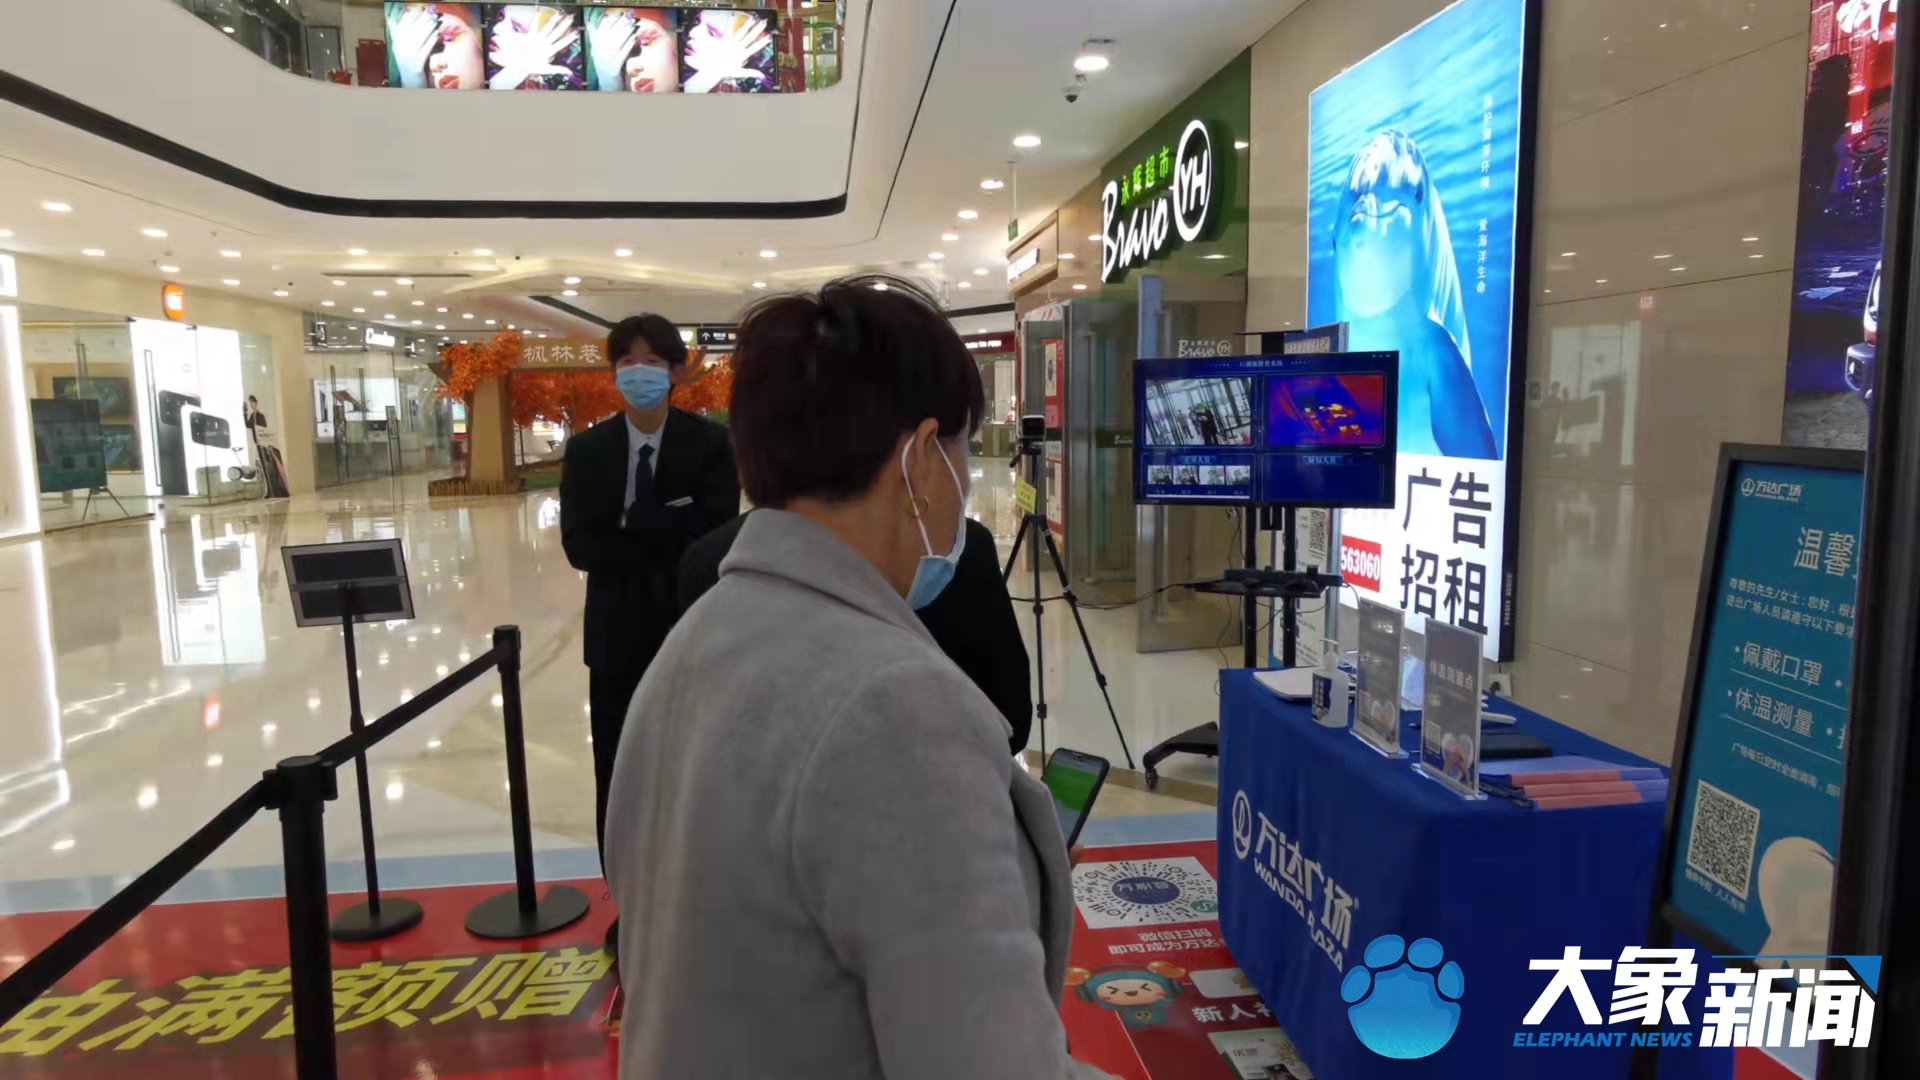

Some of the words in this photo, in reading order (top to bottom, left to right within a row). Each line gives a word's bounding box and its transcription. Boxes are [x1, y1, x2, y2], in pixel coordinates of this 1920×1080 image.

[1121, 146, 1170, 206] 永辉超市
[1101, 180, 1169, 284] Bravo
[523, 343, 602, 364] 枫林巷
[1402, 467, 1492, 549] 广告
[1756, 481, 1802, 496] 万达广场
[1341, 547, 1380, 580] 563060
[1793, 527, 1859, 579] 温馨
[1400, 543, 1488, 635] 招租
[1743, 641, 1822, 686] 佩戴口罩
[1735, 687, 1814, 737] 体温测量
[1255, 811, 1353, 949] 万达广场
[1138, 928, 1212, 942] 微信扫码
[1254, 857, 1304, 920] WANDA
[1307, 910, 1343, 973] PLAZA
[1108, 936, 1227, 955] 即可成为万达
